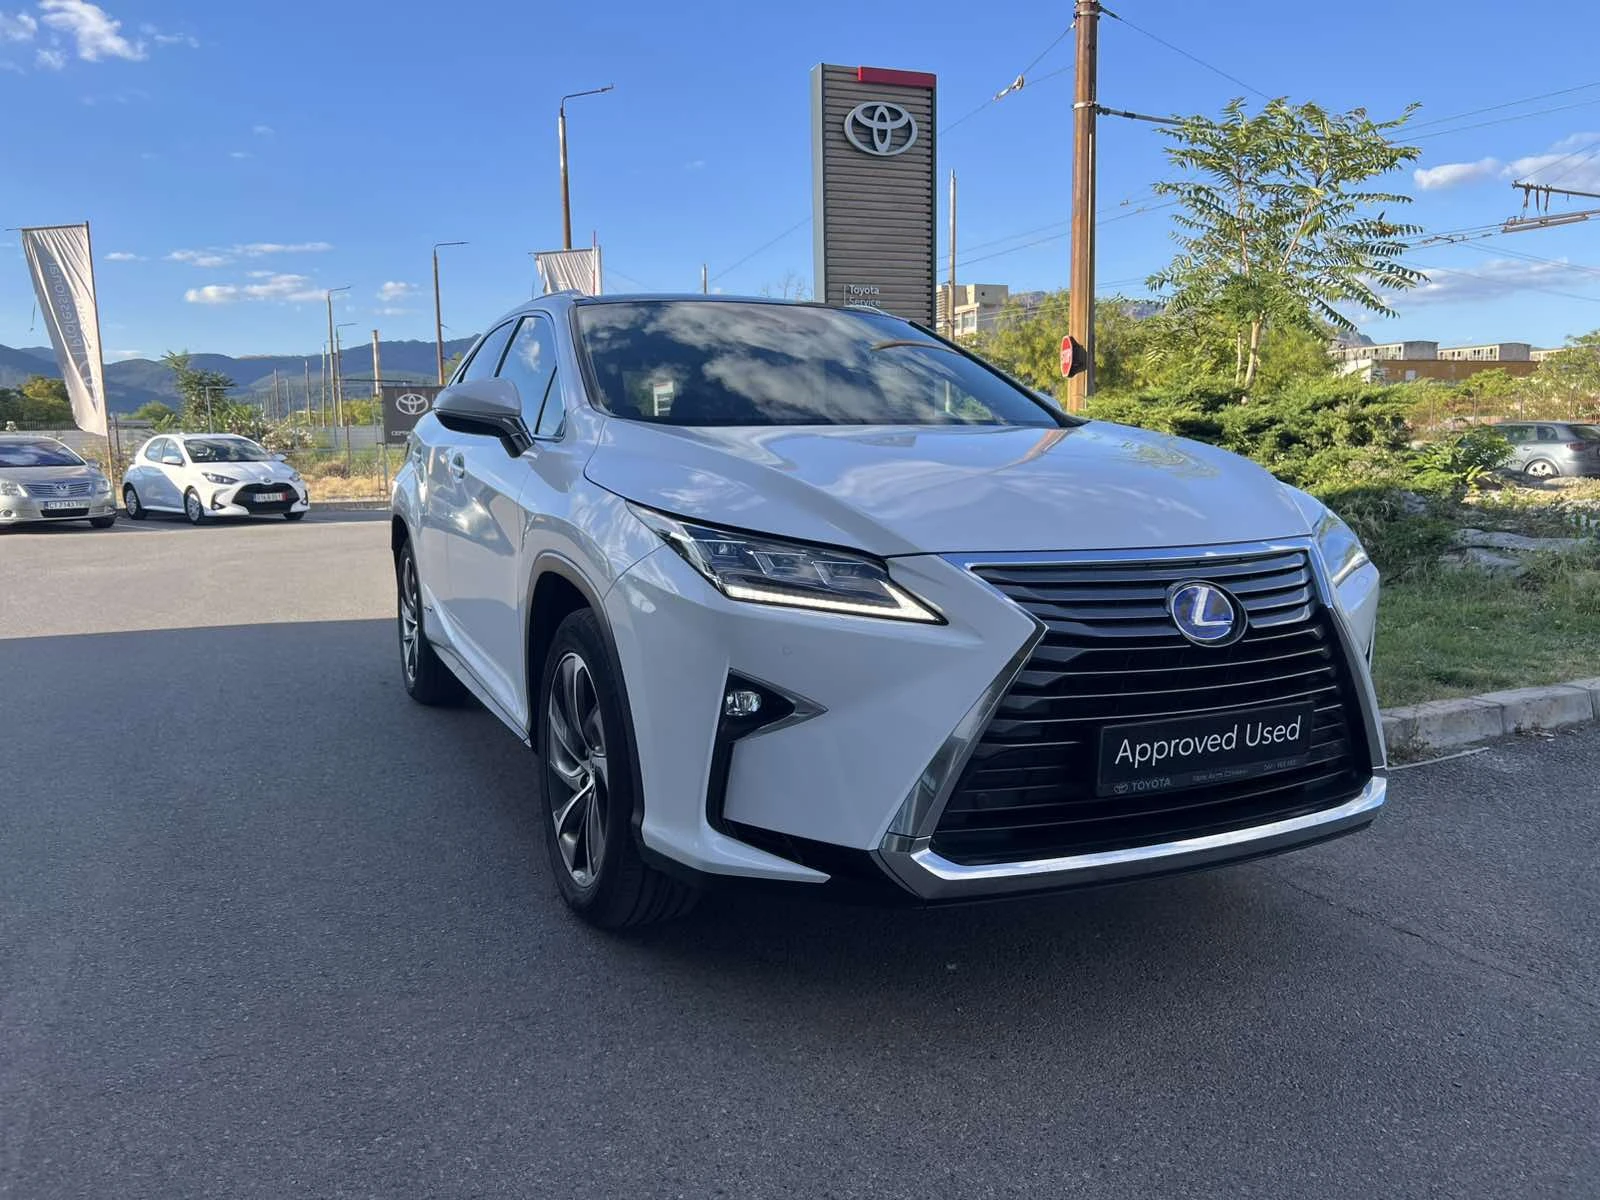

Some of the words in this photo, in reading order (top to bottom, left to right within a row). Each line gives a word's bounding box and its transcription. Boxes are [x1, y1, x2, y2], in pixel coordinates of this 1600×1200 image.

[849, 284, 880, 297] Toyota
[849, 296, 881, 307] Service
[1115, 724, 1238, 768] Approved
[1245, 715, 1302, 747] Used
[1131, 776, 1171, 791] TOYOTA
